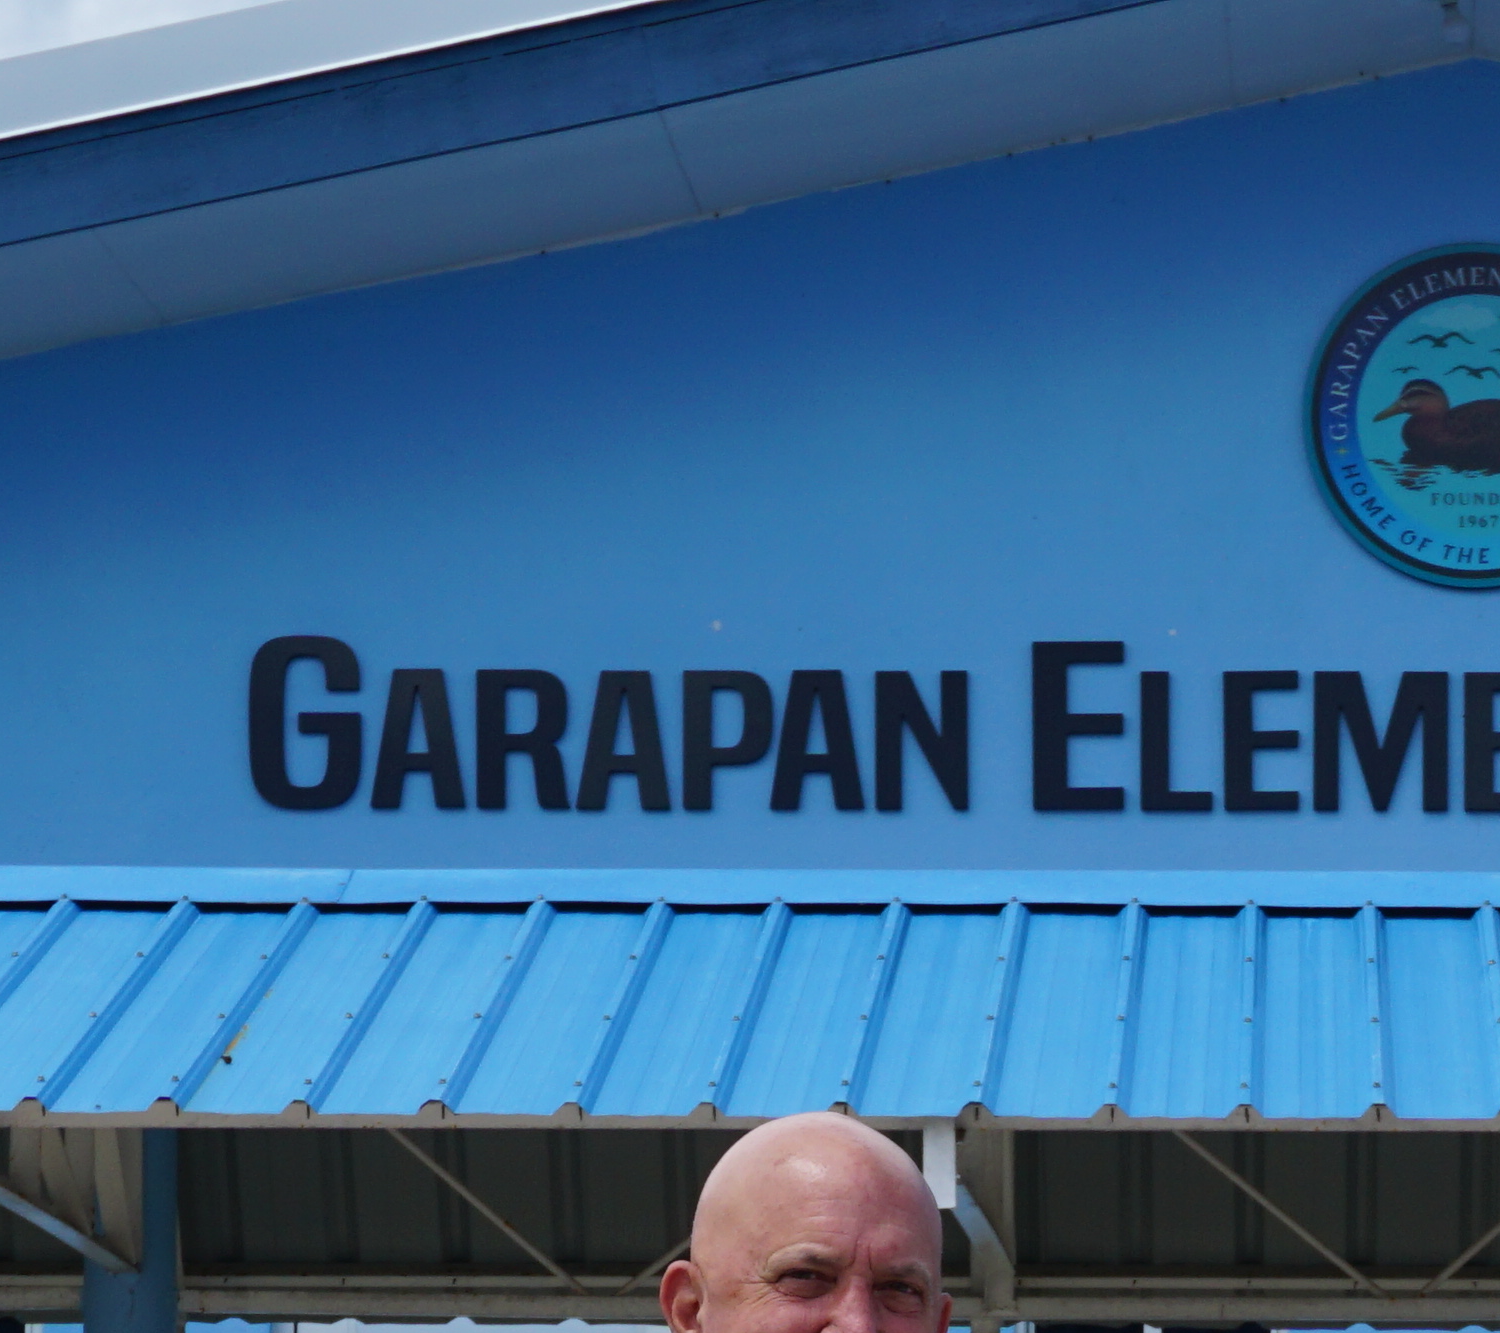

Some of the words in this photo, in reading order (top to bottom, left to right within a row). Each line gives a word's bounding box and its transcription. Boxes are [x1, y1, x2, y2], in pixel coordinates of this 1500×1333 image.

[1328, 305, 1389, 441] GARAPAN
[1341, 463, 1397, 530] HOME
[1400, 529, 1433, 552] OF
[1443, 543, 1490, 564] THE
[1458, 514, 1500, 529] 1967
[247, 634, 970, 814] GARAPAN
